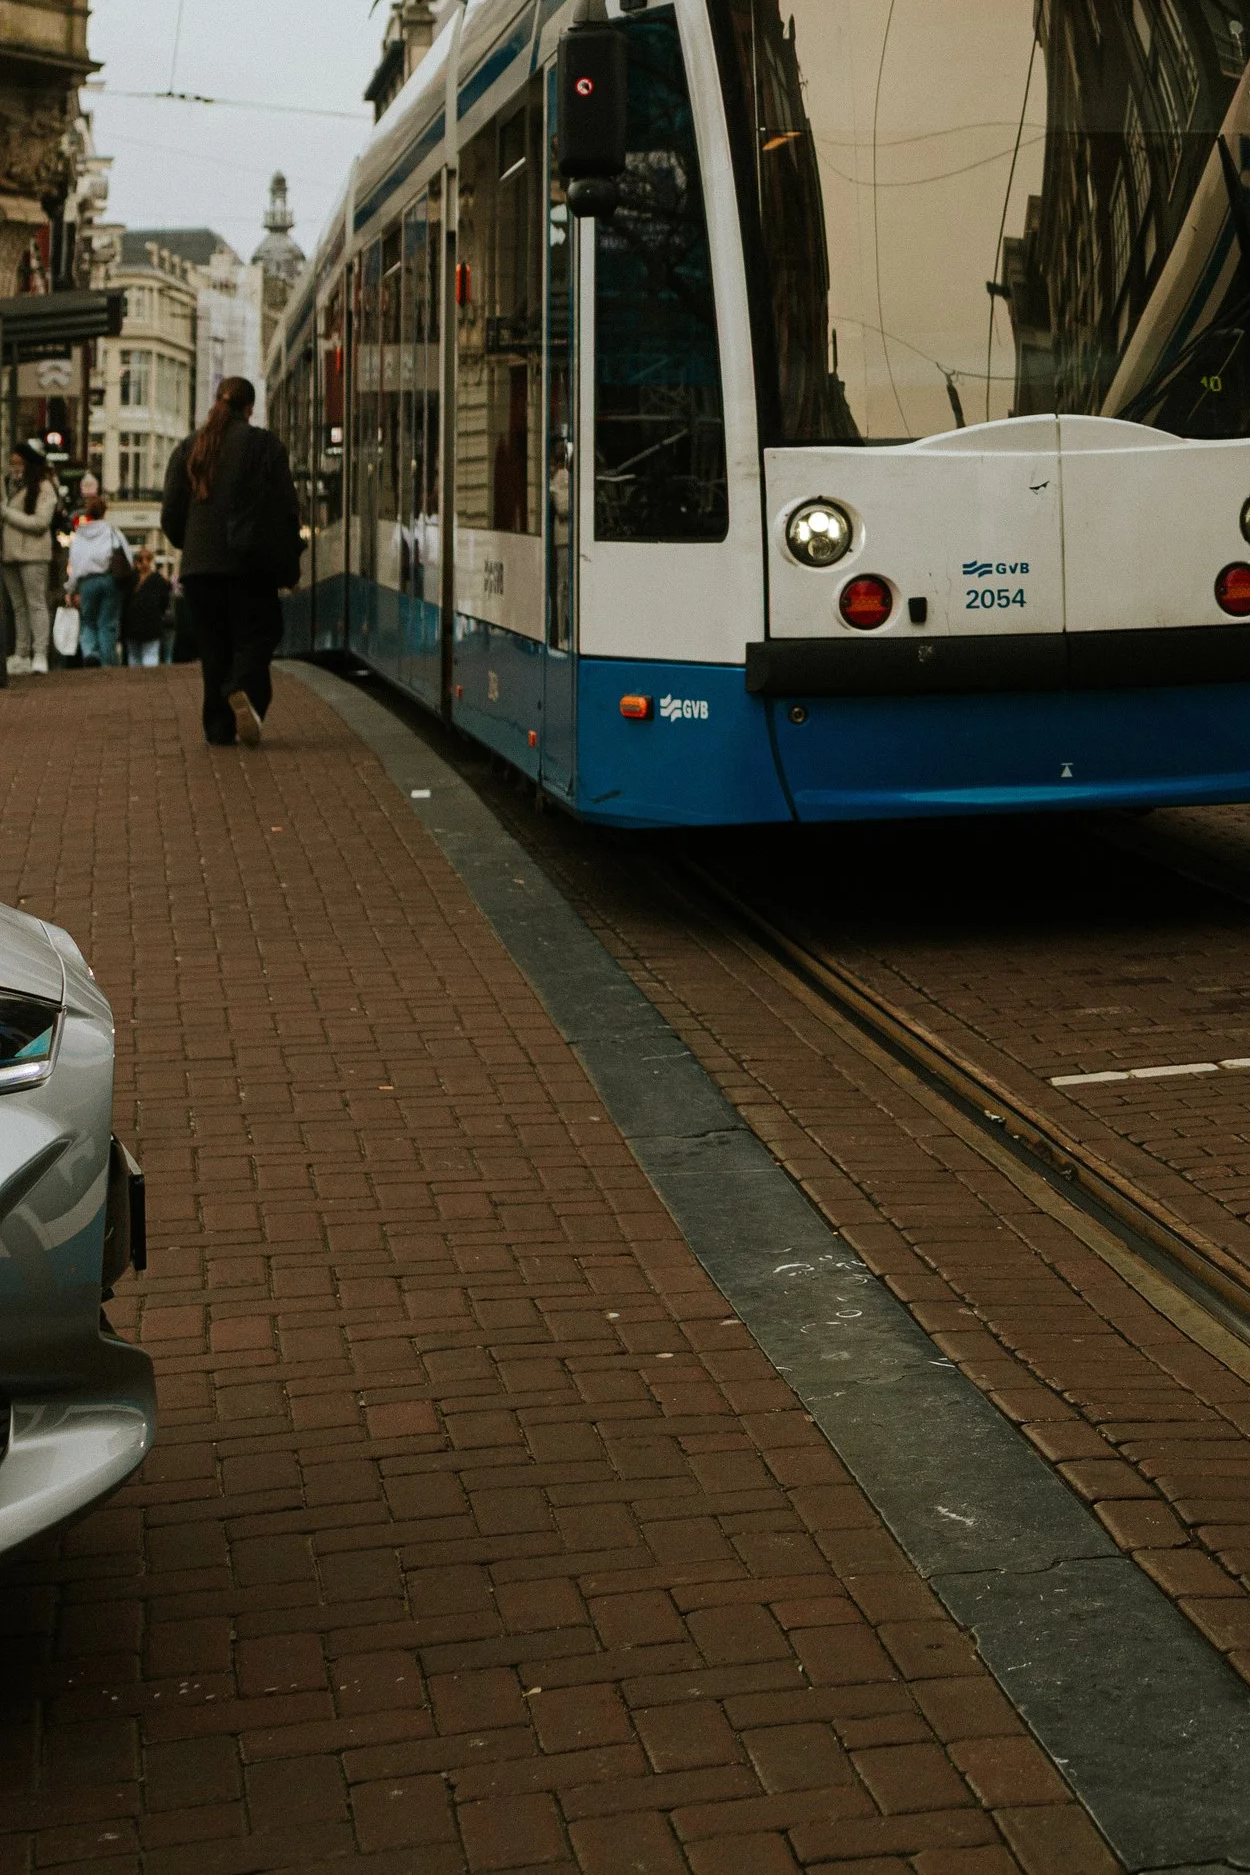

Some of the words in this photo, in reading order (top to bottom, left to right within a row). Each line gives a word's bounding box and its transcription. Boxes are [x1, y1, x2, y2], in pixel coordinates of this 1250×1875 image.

[995, 562, 1030, 575] GVB
[965, 588, 1027, 609] 2054
[682, 699, 709, 720] GVB
